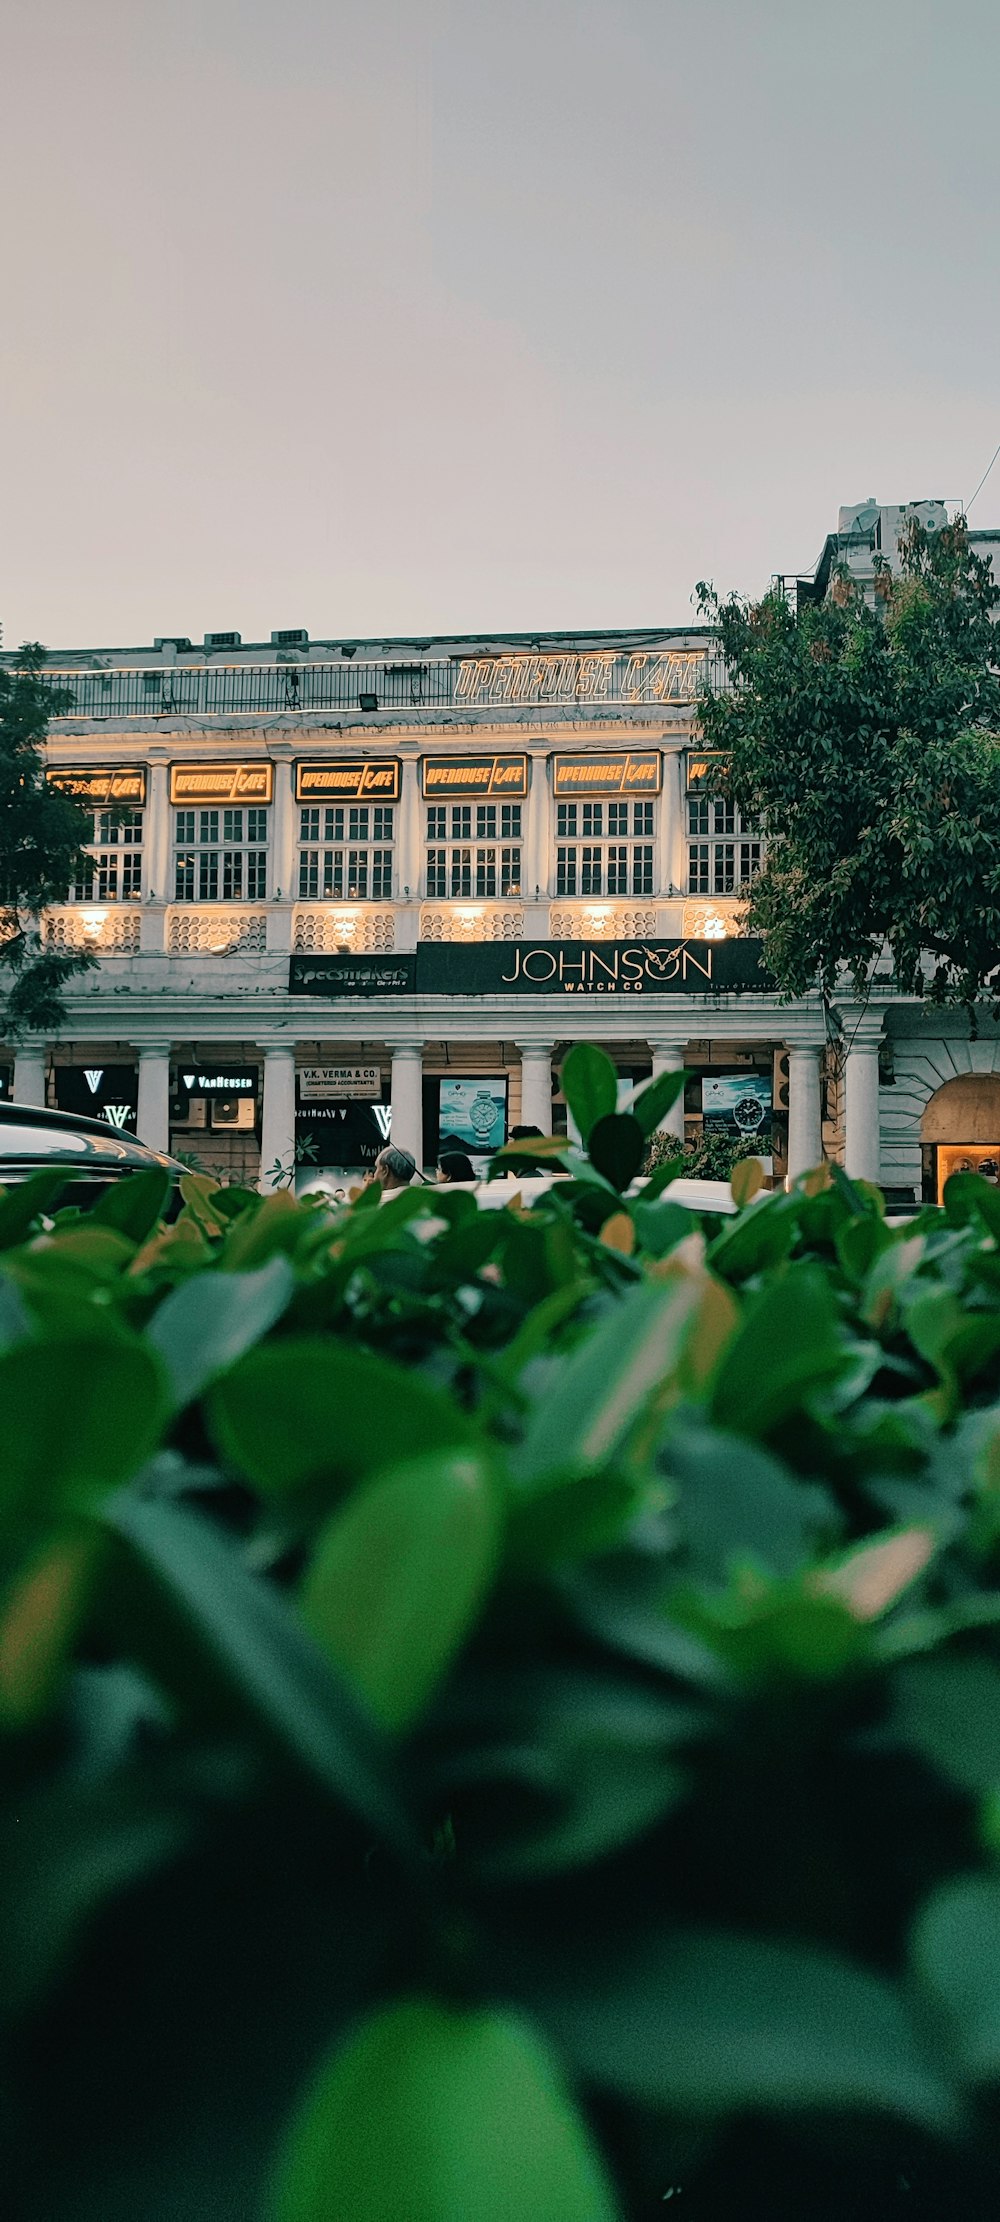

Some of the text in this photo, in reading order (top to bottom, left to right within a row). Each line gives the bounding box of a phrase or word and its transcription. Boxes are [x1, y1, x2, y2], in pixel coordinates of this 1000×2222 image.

[453, 653, 705, 701] OPENHOUSE CAFE
[301, 770, 394, 789] OPENHOUSE CAFE
[426, 766, 523, 785] OPENHOUSE CAFE
[557, 763, 656, 782] OPENHOUSE CAFE
[110, 777, 141, 797] CAFE
[175, 773, 267, 792] OPENHOUSE CAFE
[501, 947, 712, 982] JOHNSON
[293, 964, 409, 985] Specsmakers
[564, 981, 644, 992] WATCH CO
[303, 1069, 378, 1079] V.K. VERMA & CO.
